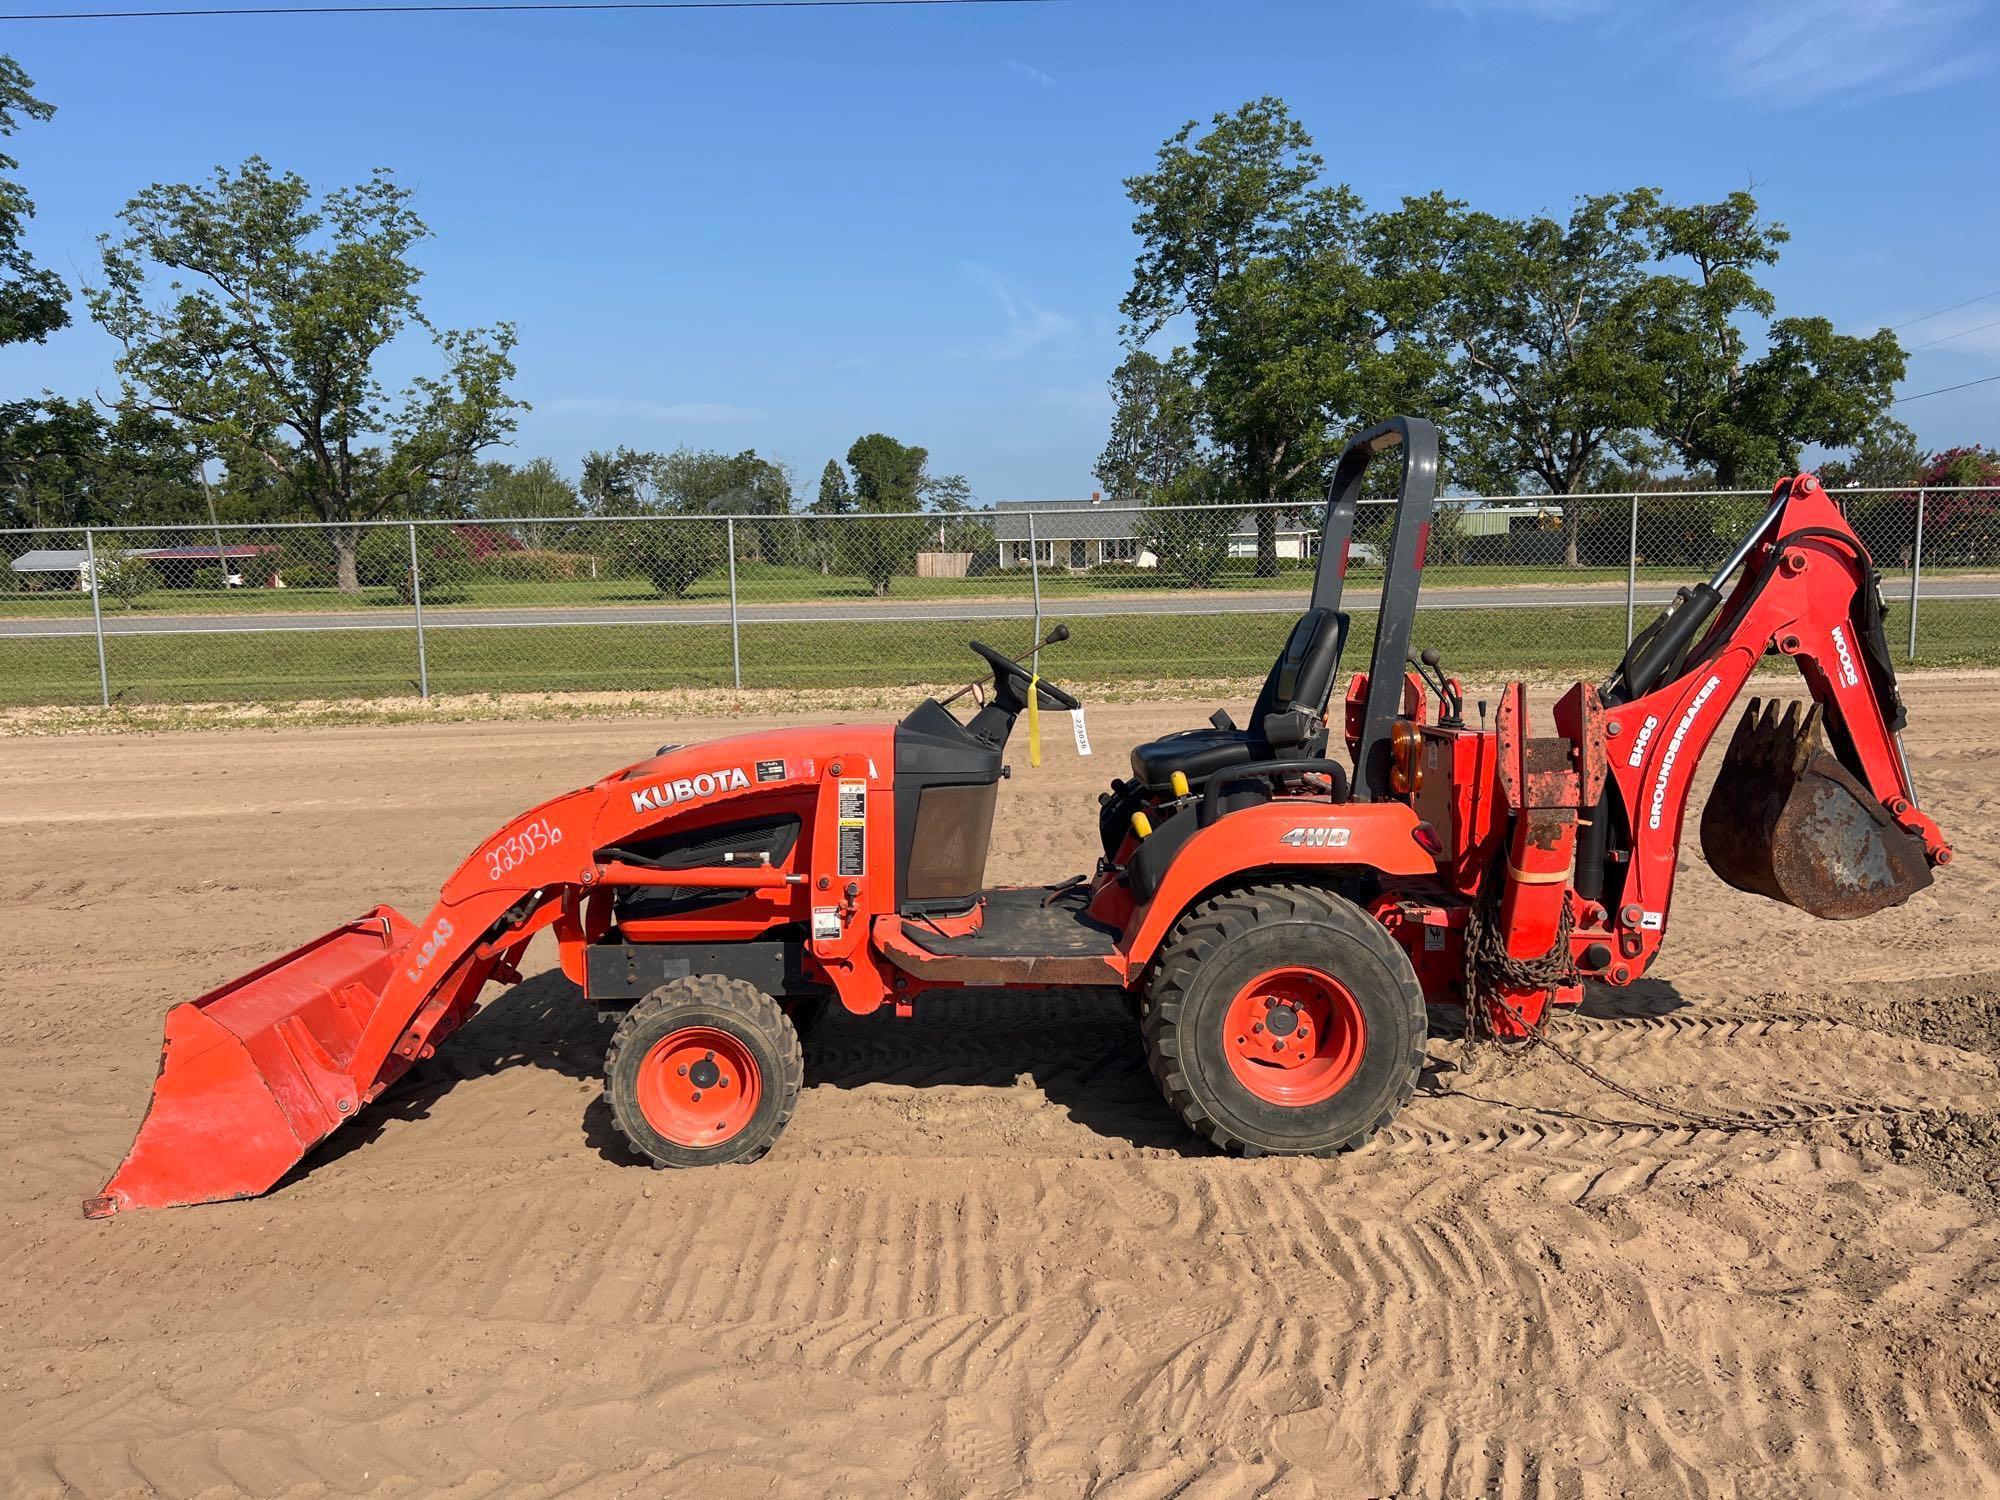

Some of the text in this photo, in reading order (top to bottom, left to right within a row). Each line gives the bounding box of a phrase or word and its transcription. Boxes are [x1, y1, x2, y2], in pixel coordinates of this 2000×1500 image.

[1830, 625, 1859, 687] WOODS
[1076, 719, 1087, 749] 223036
[1628, 714, 1659, 768] BH65
[1648, 675, 1721, 830] GROUNDBREAKER
[631, 768, 752, 813] KUBOTA
[485, 818, 563, 881] 223036
[1280, 827, 1352, 848] 4WD
